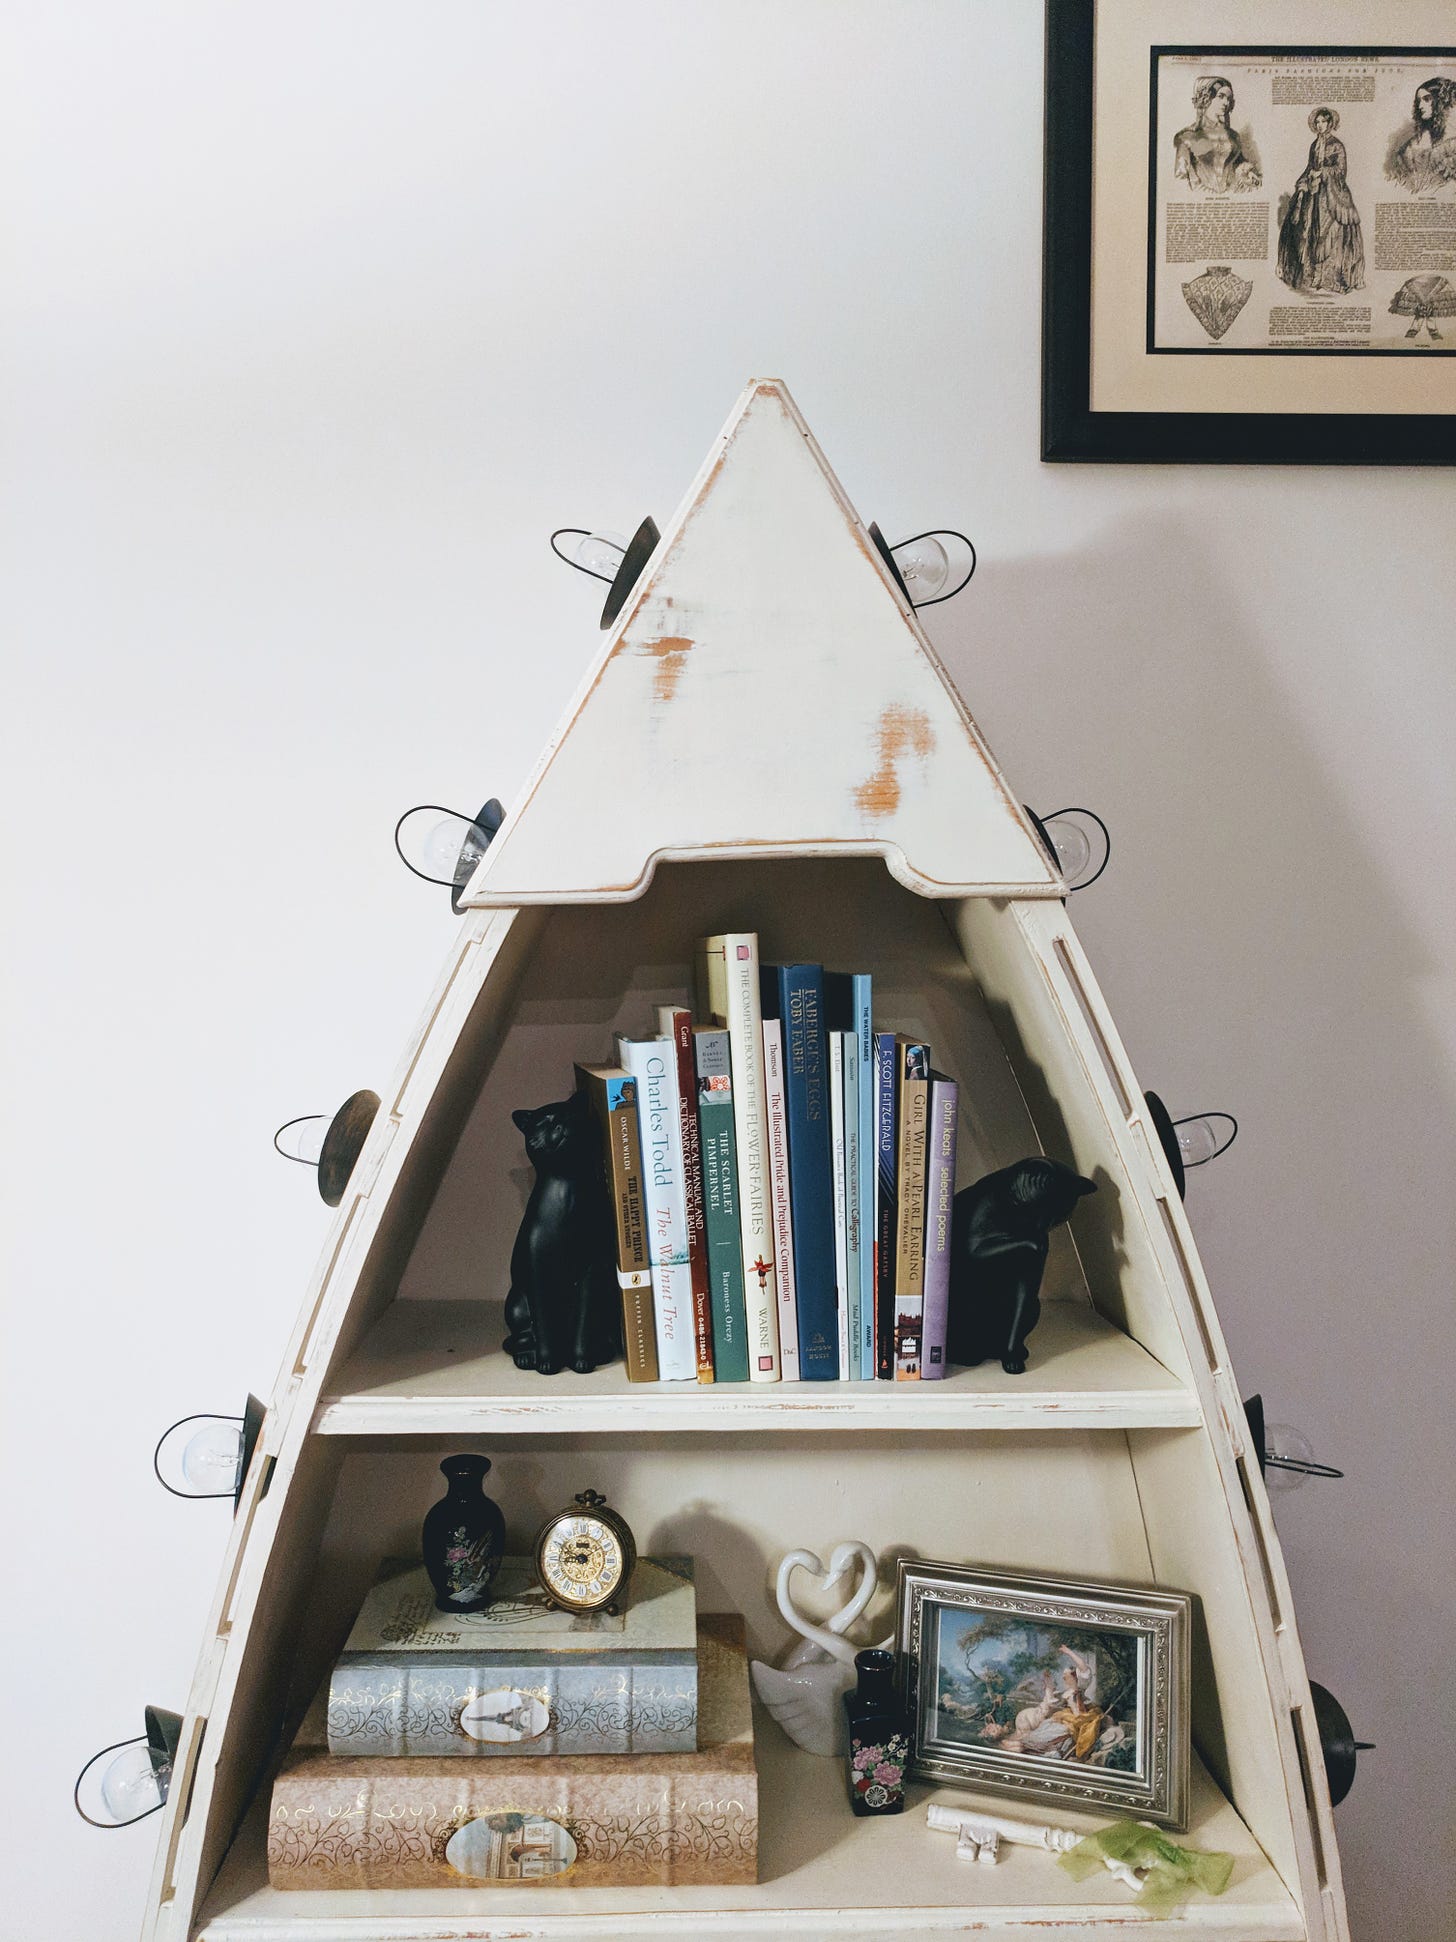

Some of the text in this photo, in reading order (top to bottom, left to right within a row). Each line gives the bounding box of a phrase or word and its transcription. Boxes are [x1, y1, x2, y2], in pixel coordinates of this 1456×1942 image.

[740, 968, 749, 988] THE
[681, 1026, 689, 1047] Grant
[742, 990, 753, 1042] COMPLETE
[790, 989, 804, 1074] TOBY FABER
[745, 1044, 754, 1072] BOOK
[746, 1074, 754, 1088] OF
[769, 1043, 778, 1077] Thomson
[882, 1059, 892, 1088] SCOTT
[647, 1057, 673, 1187] Charles Todd
[747, 1089, 756, 1109] THE
[808, 1078, 821, 1120] EGGS
[882, 1093, 891, 1151] FITZGERALD
[680, 1097, 696, 1246] DICTIONARY OF CLASSICAL BALLET
[689, 1113, 703, 1230] TECHNICAL MANUAL AND
[707, 1138, 719, 1210] PIMPERNEL
[719, 1130, 733, 1215] THE SCARLET
[905, 1162, 910, 1172] BY
[909, 1094, 926, 1281] GIRL WITH A PEARL EARRING
[936, 1099, 955, 1252] john keats selected poems
[627, 1176, 643, 1262] THE HAPPY PRINCE
[771, 1092, 792, 1302] The Illustrated Pride and Prejudice Companion
[850, 1208, 859, 1252] Calligraphy
[656, 1207, 677, 1340] The Walnut Tree
[696, 1293, 705, 1315] Dover
[722, 1271, 733, 1343] Baroness Orczy
[759, 1307, 769, 1348] WARNE
[637, 1329, 645, 1368] CLASSICS
